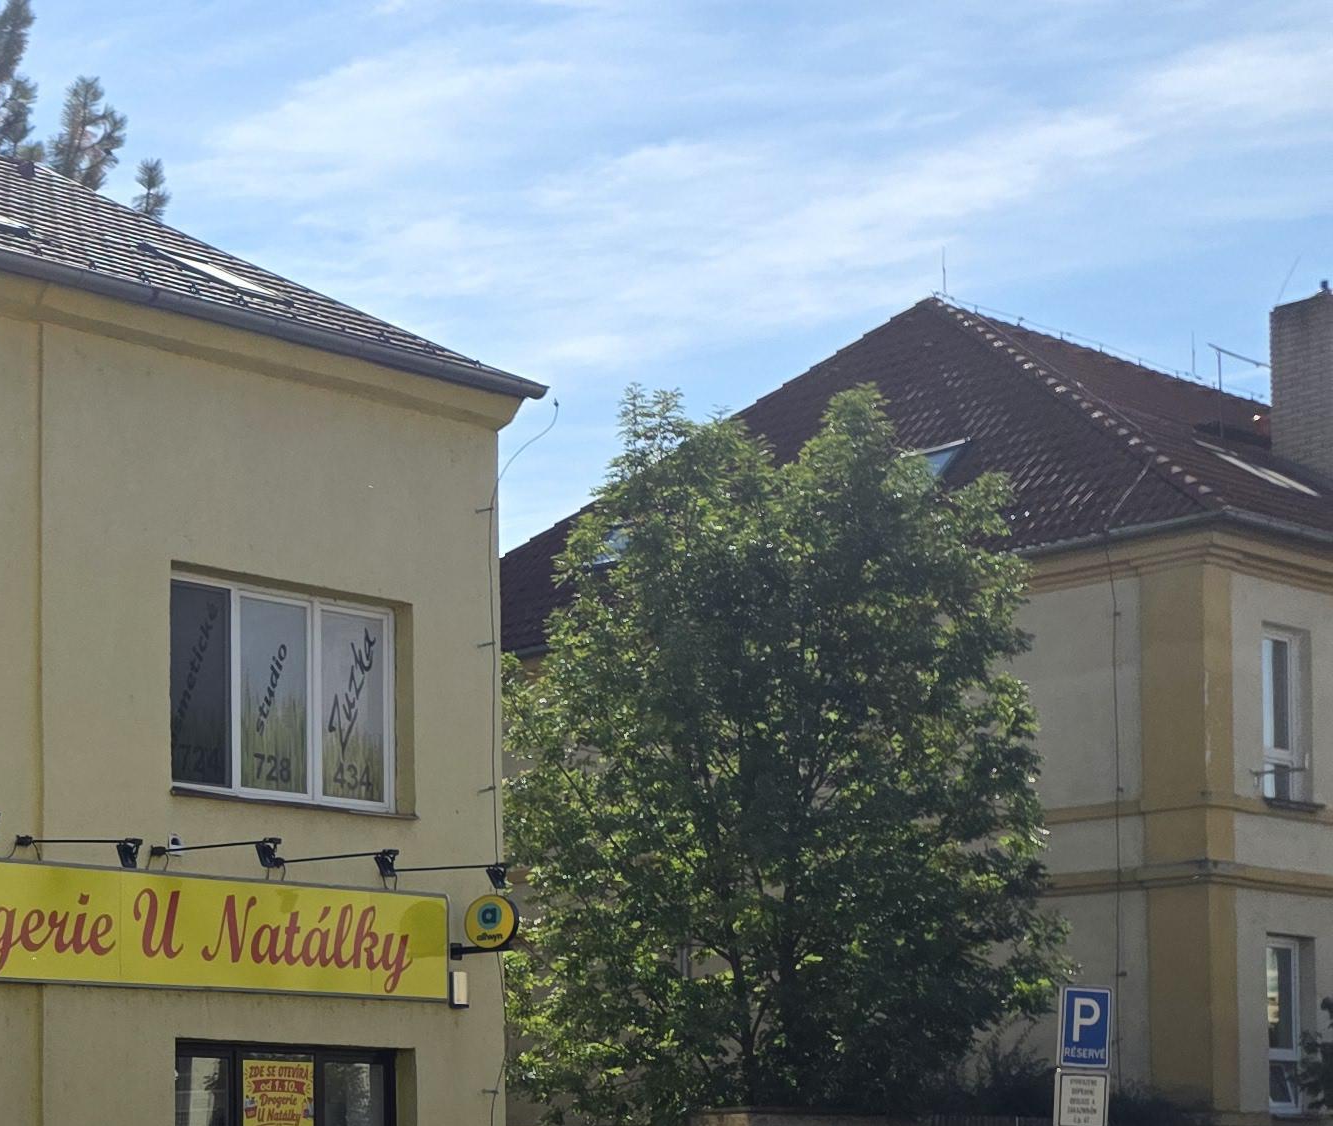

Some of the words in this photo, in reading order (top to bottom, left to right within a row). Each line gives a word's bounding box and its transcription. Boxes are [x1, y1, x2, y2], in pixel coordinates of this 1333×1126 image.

[256, 643, 288, 737] studio
[253, 752, 292, 784] 728
[333, 762, 374, 793] 434
[133, 887, 184, 961] U
[201, 893, 413, 995] Natálky
[1072, 997, 1101, 1042] P
[249, 1065, 265, 1079] ZDE
[266, 1065, 277, 1078] SE
[1064, 1045, 1106, 1060] RÉSERVÉ
[267, 1108, 302, 1126] Natálky
